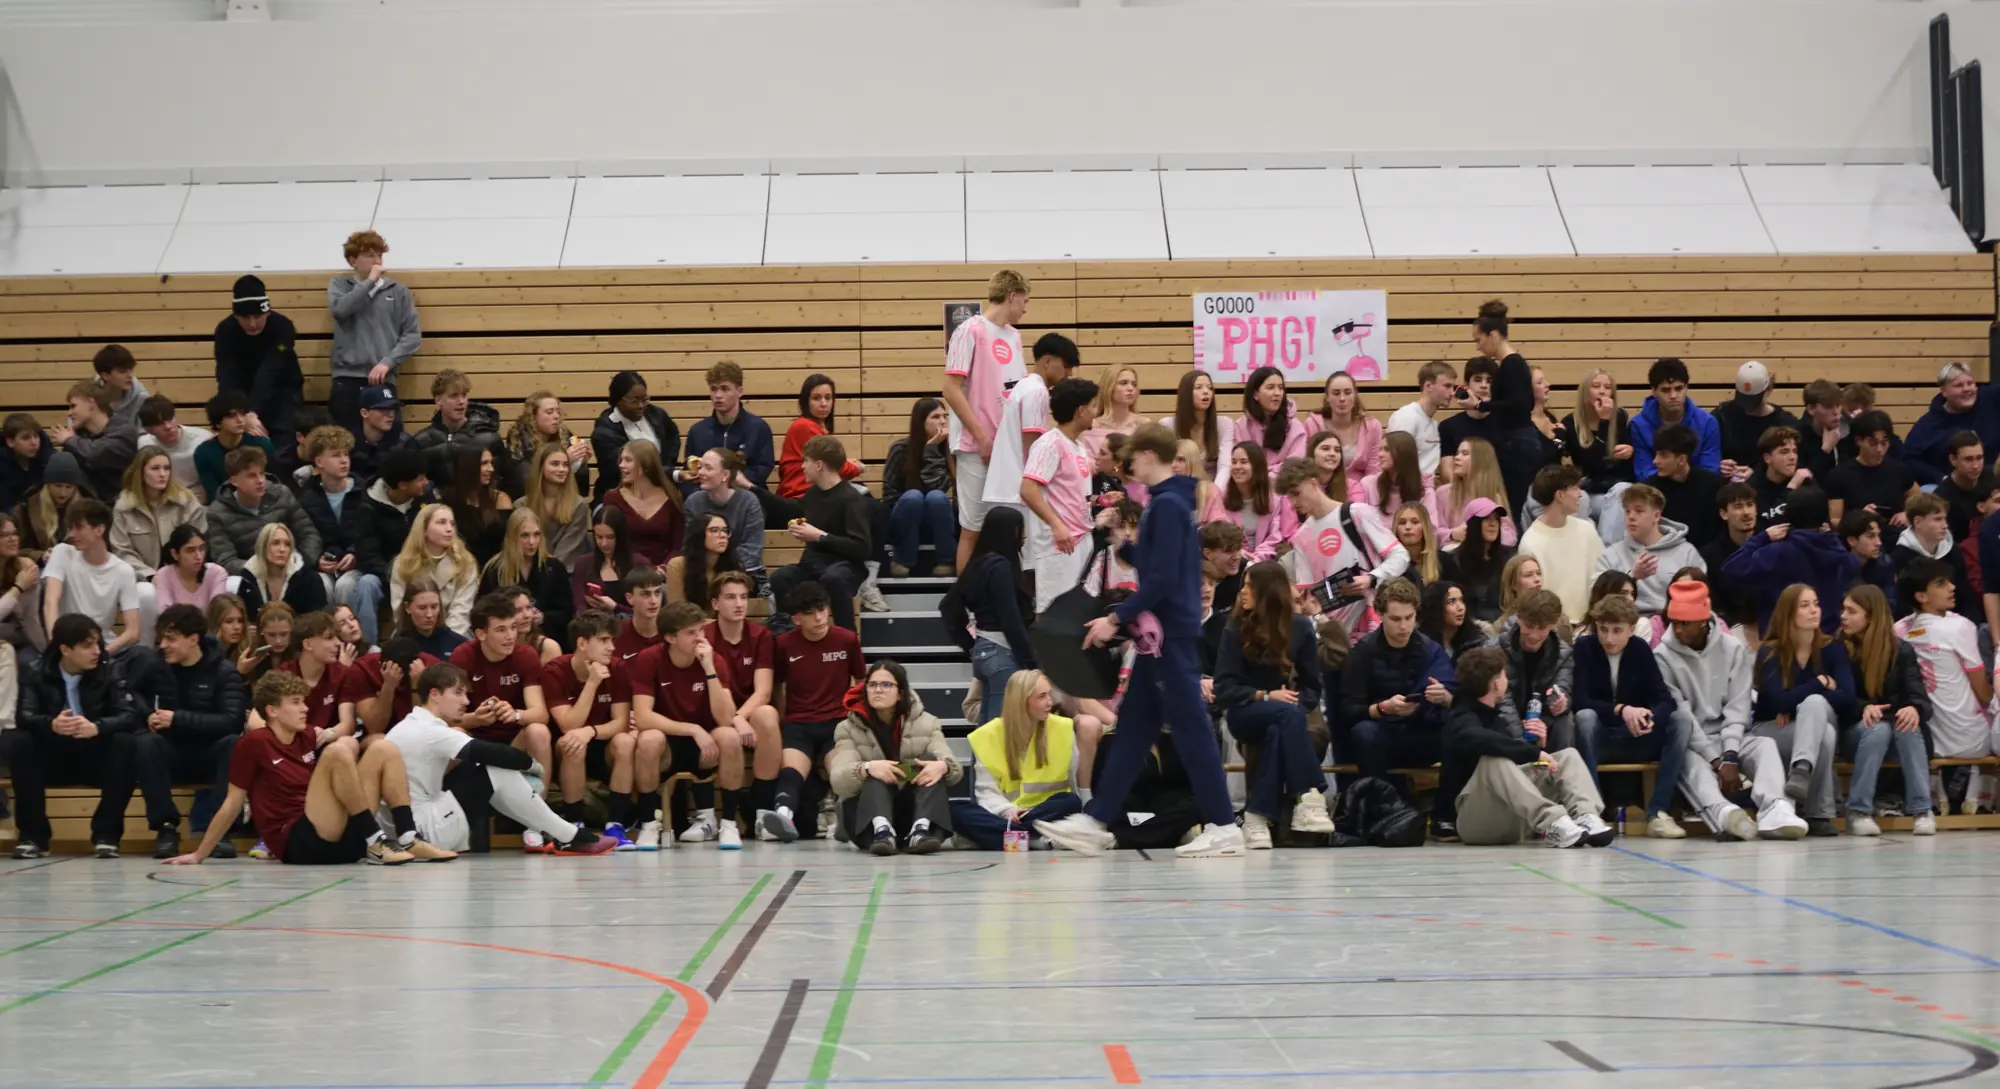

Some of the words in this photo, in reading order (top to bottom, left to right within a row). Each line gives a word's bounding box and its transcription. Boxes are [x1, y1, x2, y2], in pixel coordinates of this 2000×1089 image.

[1204, 297, 1254, 314] GOOOO
[1217, 315, 1316, 371] PHG!
[822, 650, 848, 662] MPG
[500, 673, 520, 685] MPG
